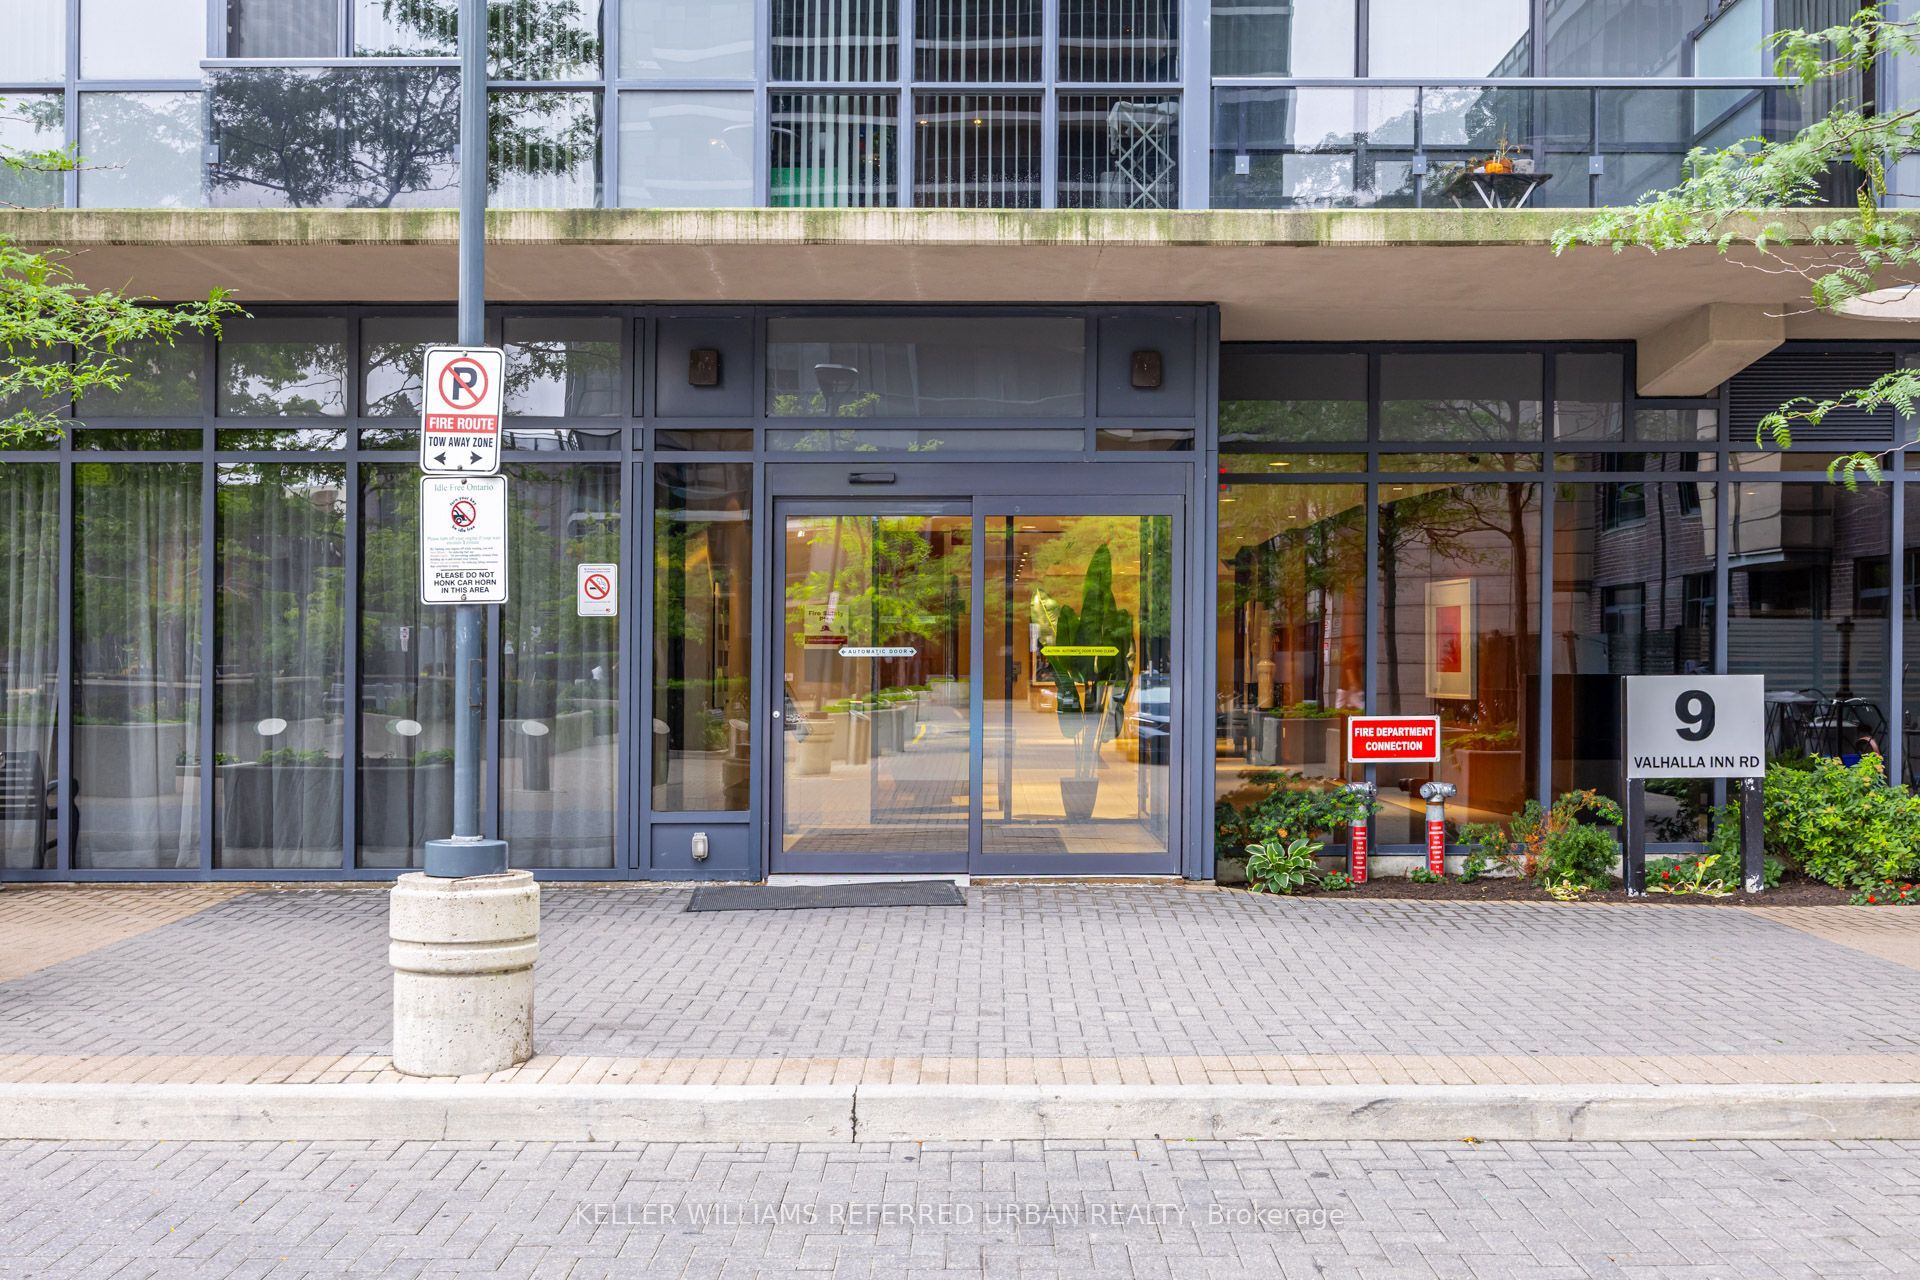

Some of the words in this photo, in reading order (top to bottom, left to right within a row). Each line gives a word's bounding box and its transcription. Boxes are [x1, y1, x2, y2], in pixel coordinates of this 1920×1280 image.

[429, 416, 454, 430] FIRE
[457, 417, 495, 431] ROUTE
[429, 436, 447, 447] TOW
[448, 436, 471, 447] AWAY
[473, 437, 494, 448] ZONE
[434, 483, 448, 491] Idle
[449, 483, 465, 491] Free
[466, 483, 494, 491] Ontario
[435, 571, 465, 579] PLEASE
[433, 579, 456, 587] HONK
[451, 586, 468, 594] THIS
[1674, 689, 1716, 742] 9
[1354, 727, 1375, 737] FIRE
[1376, 726, 1434, 737] DEPARTMENT
[1365, 741, 1423, 751] CONNECTION
[1633, 756, 1706, 769] VALHALLA
[1710, 755, 1735, 768] INN
[1739, 755, 1760, 768] RD
